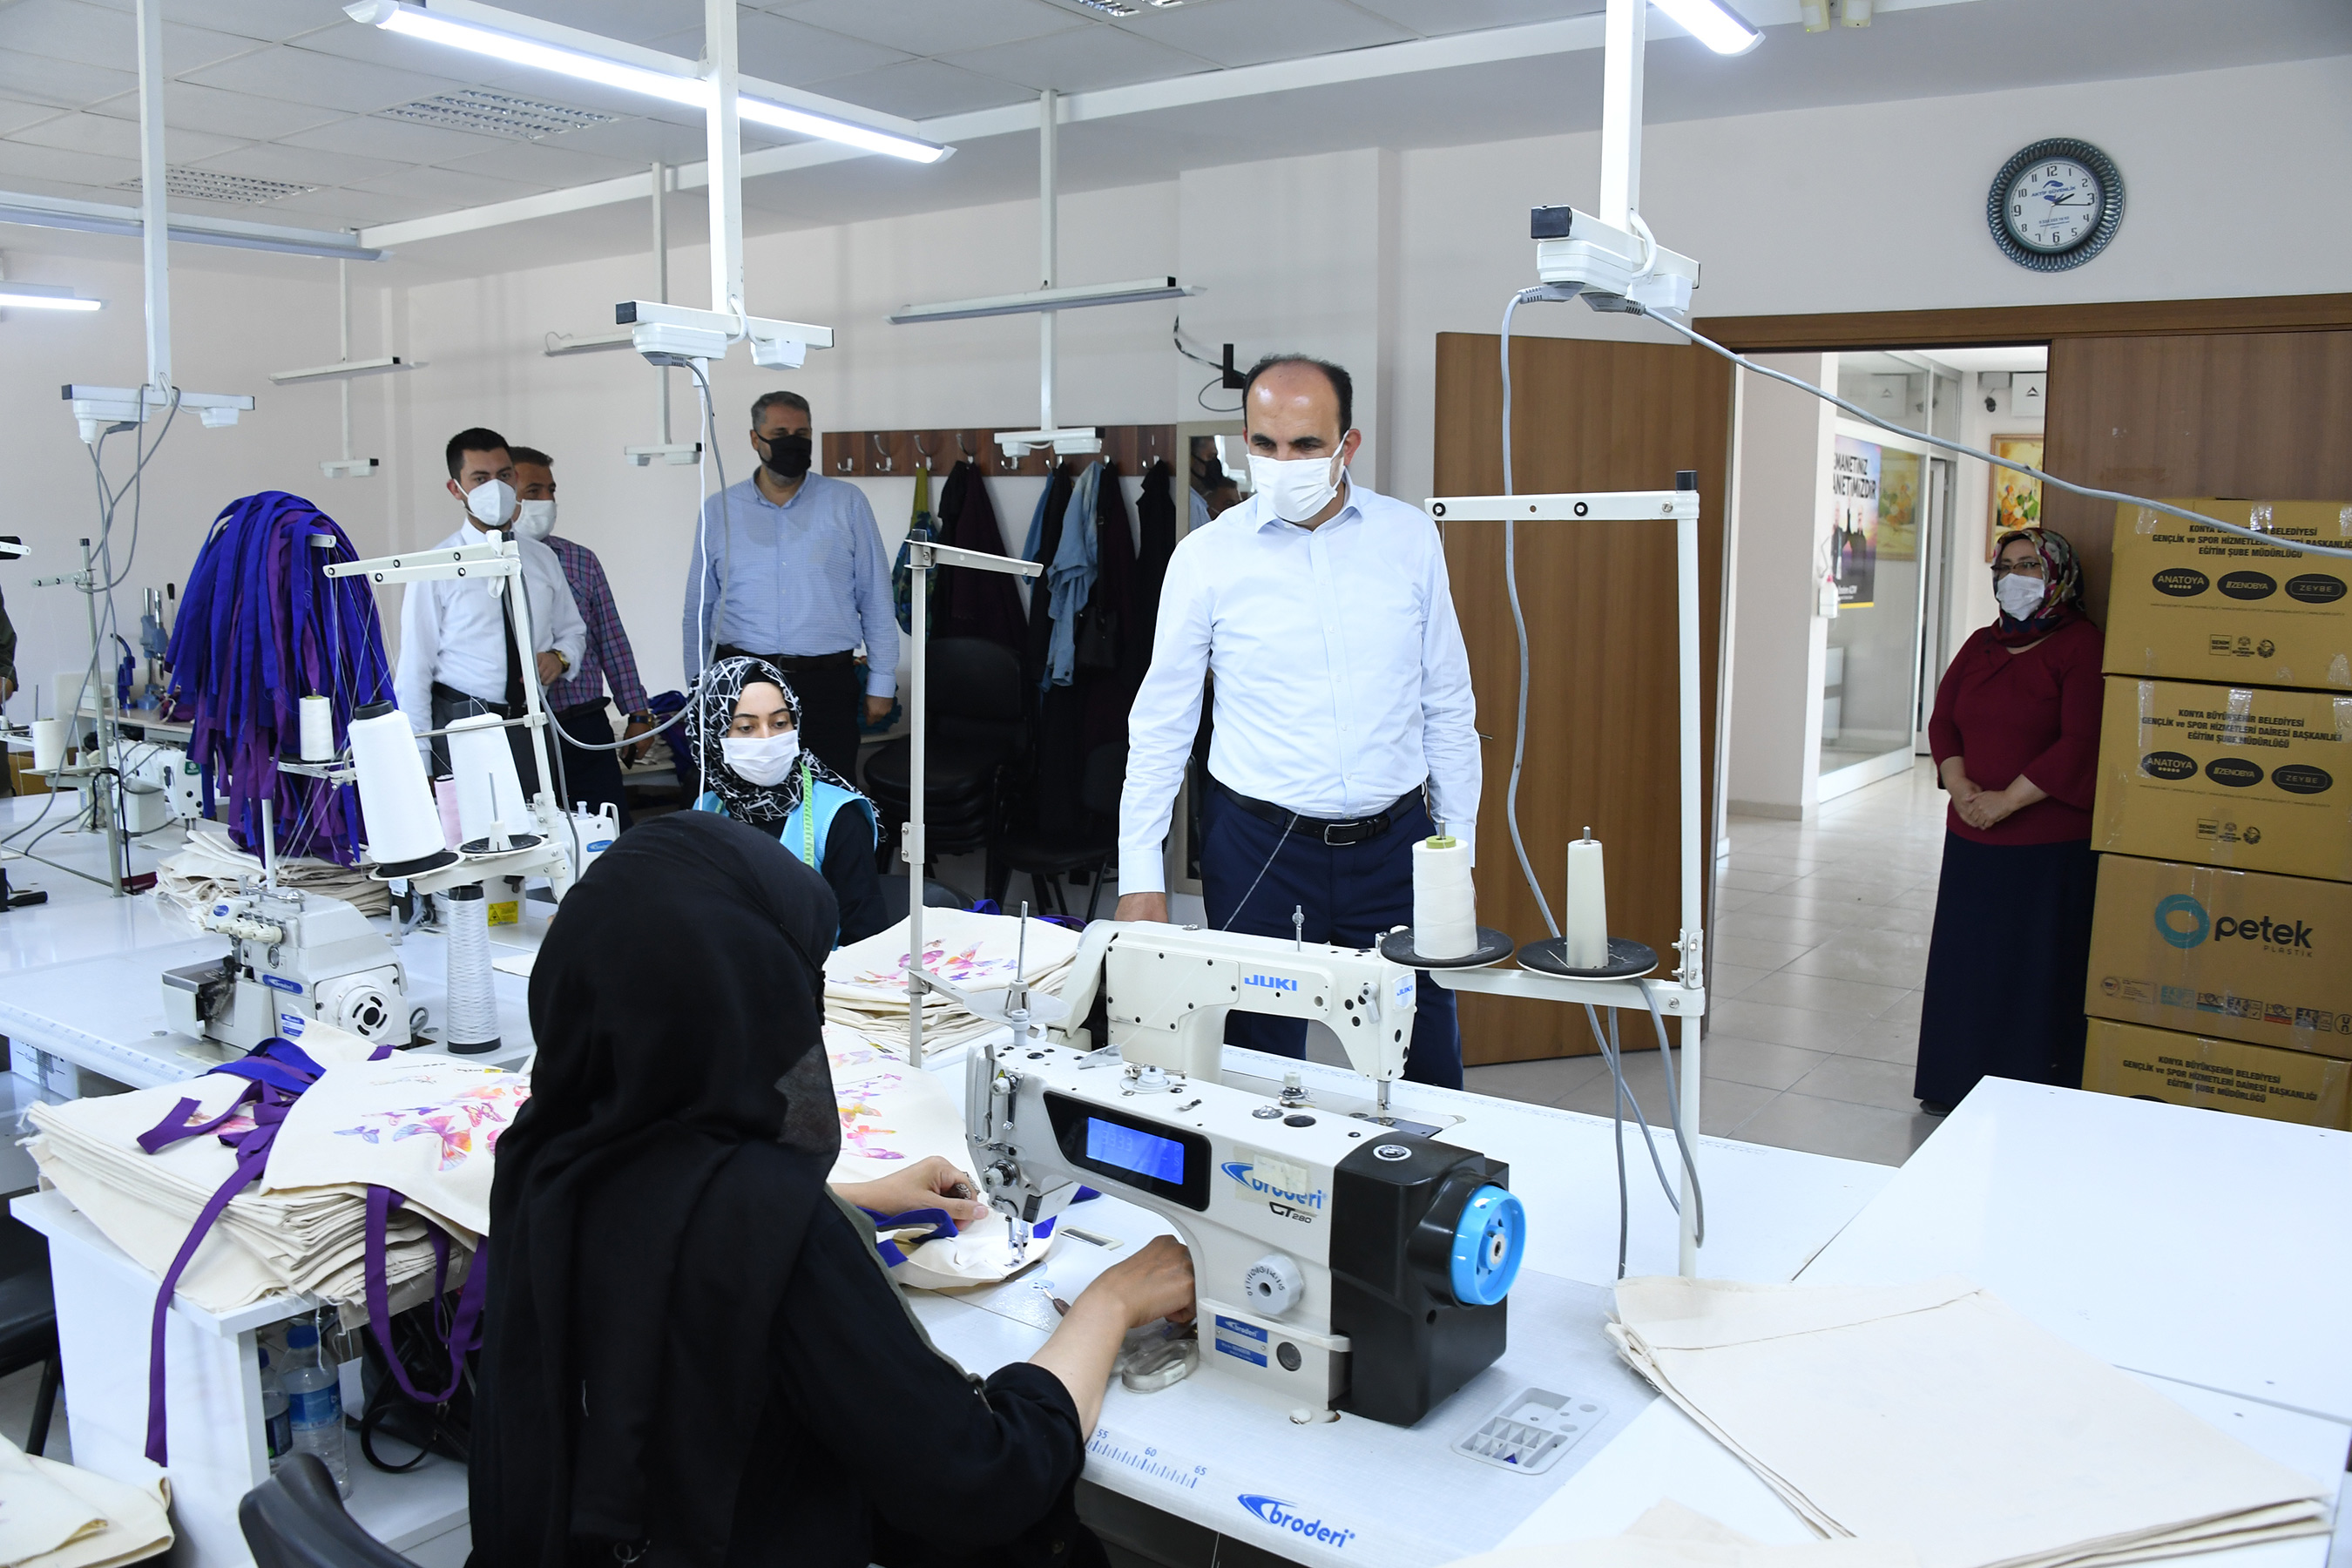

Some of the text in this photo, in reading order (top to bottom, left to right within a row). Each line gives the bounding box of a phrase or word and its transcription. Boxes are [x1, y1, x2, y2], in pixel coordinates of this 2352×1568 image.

[2047, 166, 2058, 178] 12
[2068, 167, 2072, 177] 1
[2031, 174, 2038, 183] 11
[2081, 178, 2088, 187] 2
[2018, 188, 2027, 198] 10
[2087, 193, 2094, 206] 3
[2013, 205, 2022, 217] 9
[2083, 213, 2090, 222] 4
[2021, 224, 2027, 233] 8
[2071, 227, 2078, 236] 5
[2035, 233, 2041, 242] 7
[2052, 232, 2060, 243] 6
[2189, 524, 2214, 533] KONYA
[2270, 526, 2317, 536] BELEDİYESİ
[2153, 534, 2185, 544] GENÇLİK
[2199, 545, 2226, 555] EĞİTİM
[2227, 548, 2249, 558] ŞUBE
[2158, 575, 2205, 585] ANATOYA
[2300, 585, 2332, 593] ZEYBE
[2179, 709, 2204, 718] KONYA
[2258, 716, 2304, 727] BELEDİYESİ
[2142, 717, 2173, 727] GENÇLİK
[2187, 721, 2207, 730] SPOR
[2210, 722, 2256, 734] HİZMETLERİ
[2258, 727, 2290, 737] DAİRESİ
[2187, 731, 2213, 741] EĞİTİM
[2147, 757, 2193, 769] ANATOYA
[2286, 775, 2318, 784] ZEYBE
[2214, 916, 2313, 949] petek
[2263, 945, 2313, 958] PLASTİK
[1244, 974, 1297, 991] JUKI
[1396, 984, 1413, 997] JUKI
[2159, 1056, 2183, 1066] KONYA
[2166, 1068, 2186, 1078] SPOR
[1096, 1428, 1109, 1439] 55
[1144, 1446, 1157, 1457] 60
[1194, 1465, 1207, 1477] 65
[1269, 1503, 1349, 1548] broderi
